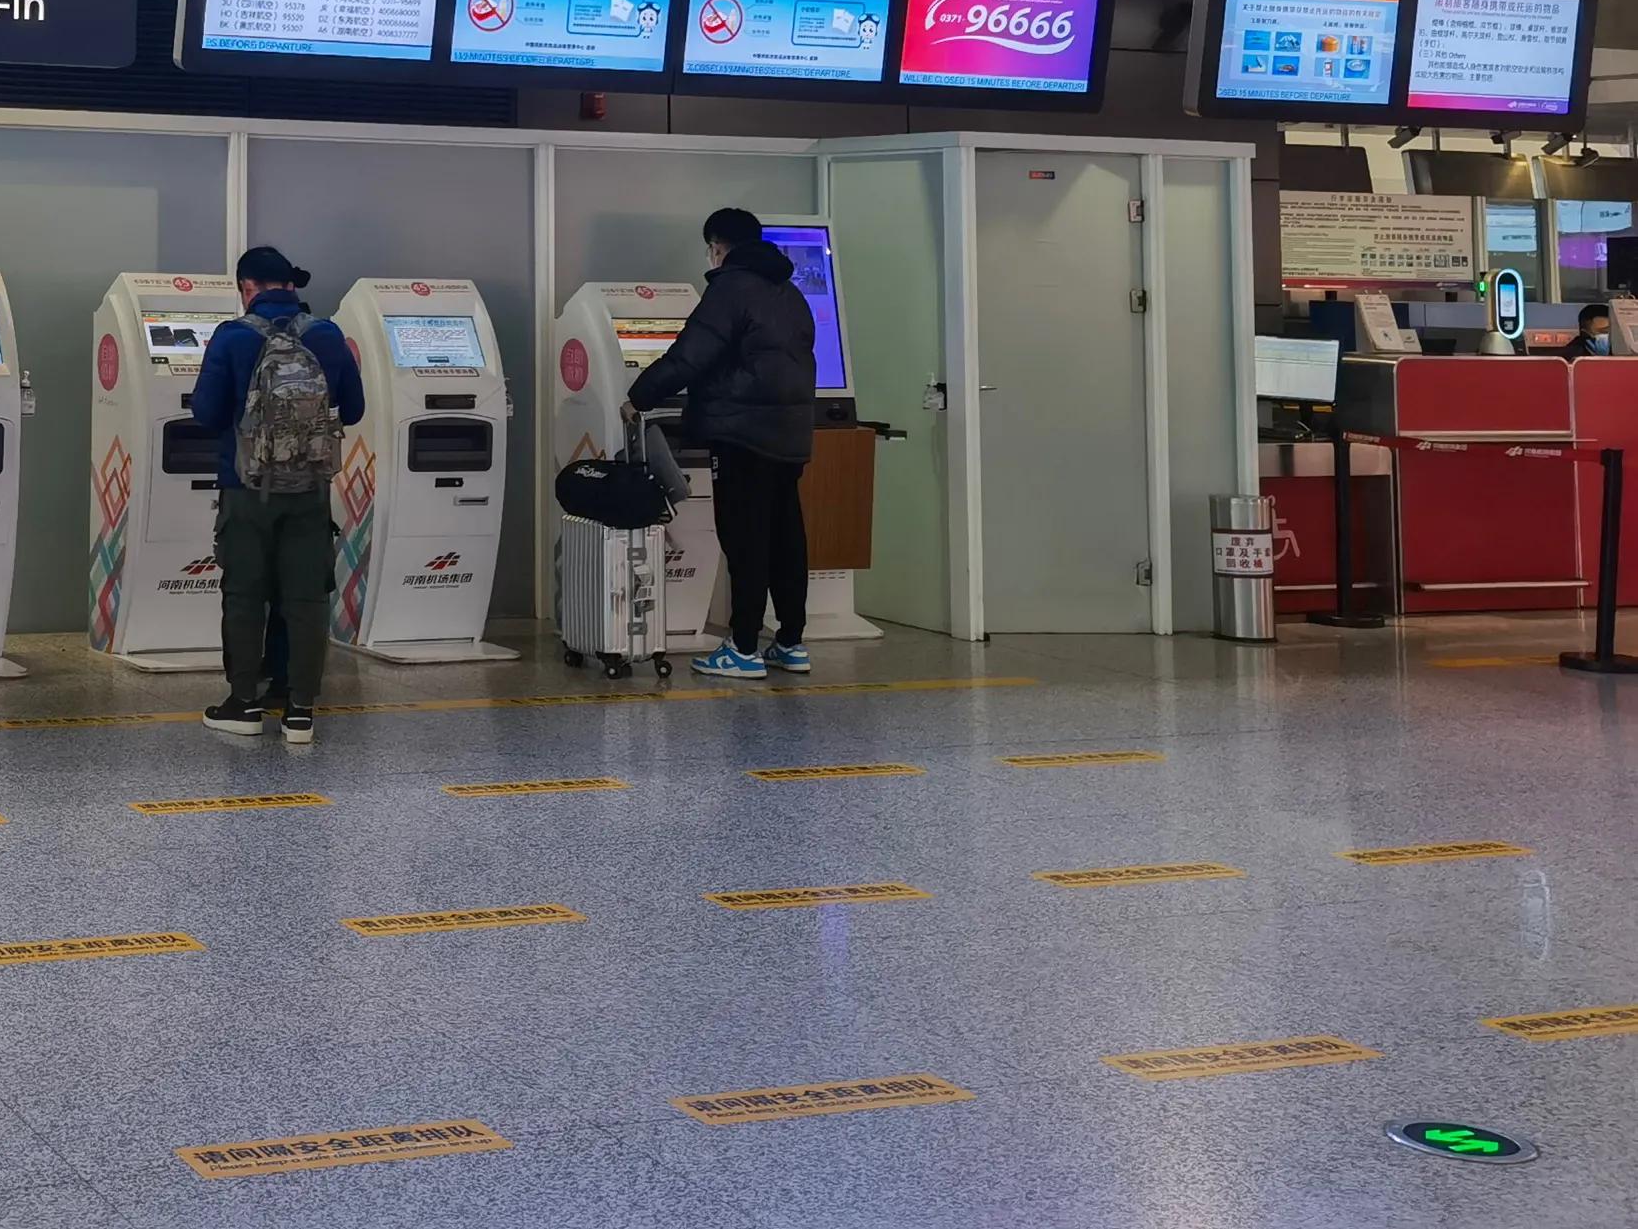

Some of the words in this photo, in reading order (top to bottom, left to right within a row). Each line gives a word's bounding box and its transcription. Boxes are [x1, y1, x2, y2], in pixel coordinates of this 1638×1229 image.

[965, 4, 1074, 39] 96666
[157, 578, 223, 591] 河南机场集
[402, 572, 473, 586] 河南机场集团
[686, 1077, 946, 1112] 请间隔安全距离排队
[194, 1125, 484, 1164] 请间隔安全距离排队
